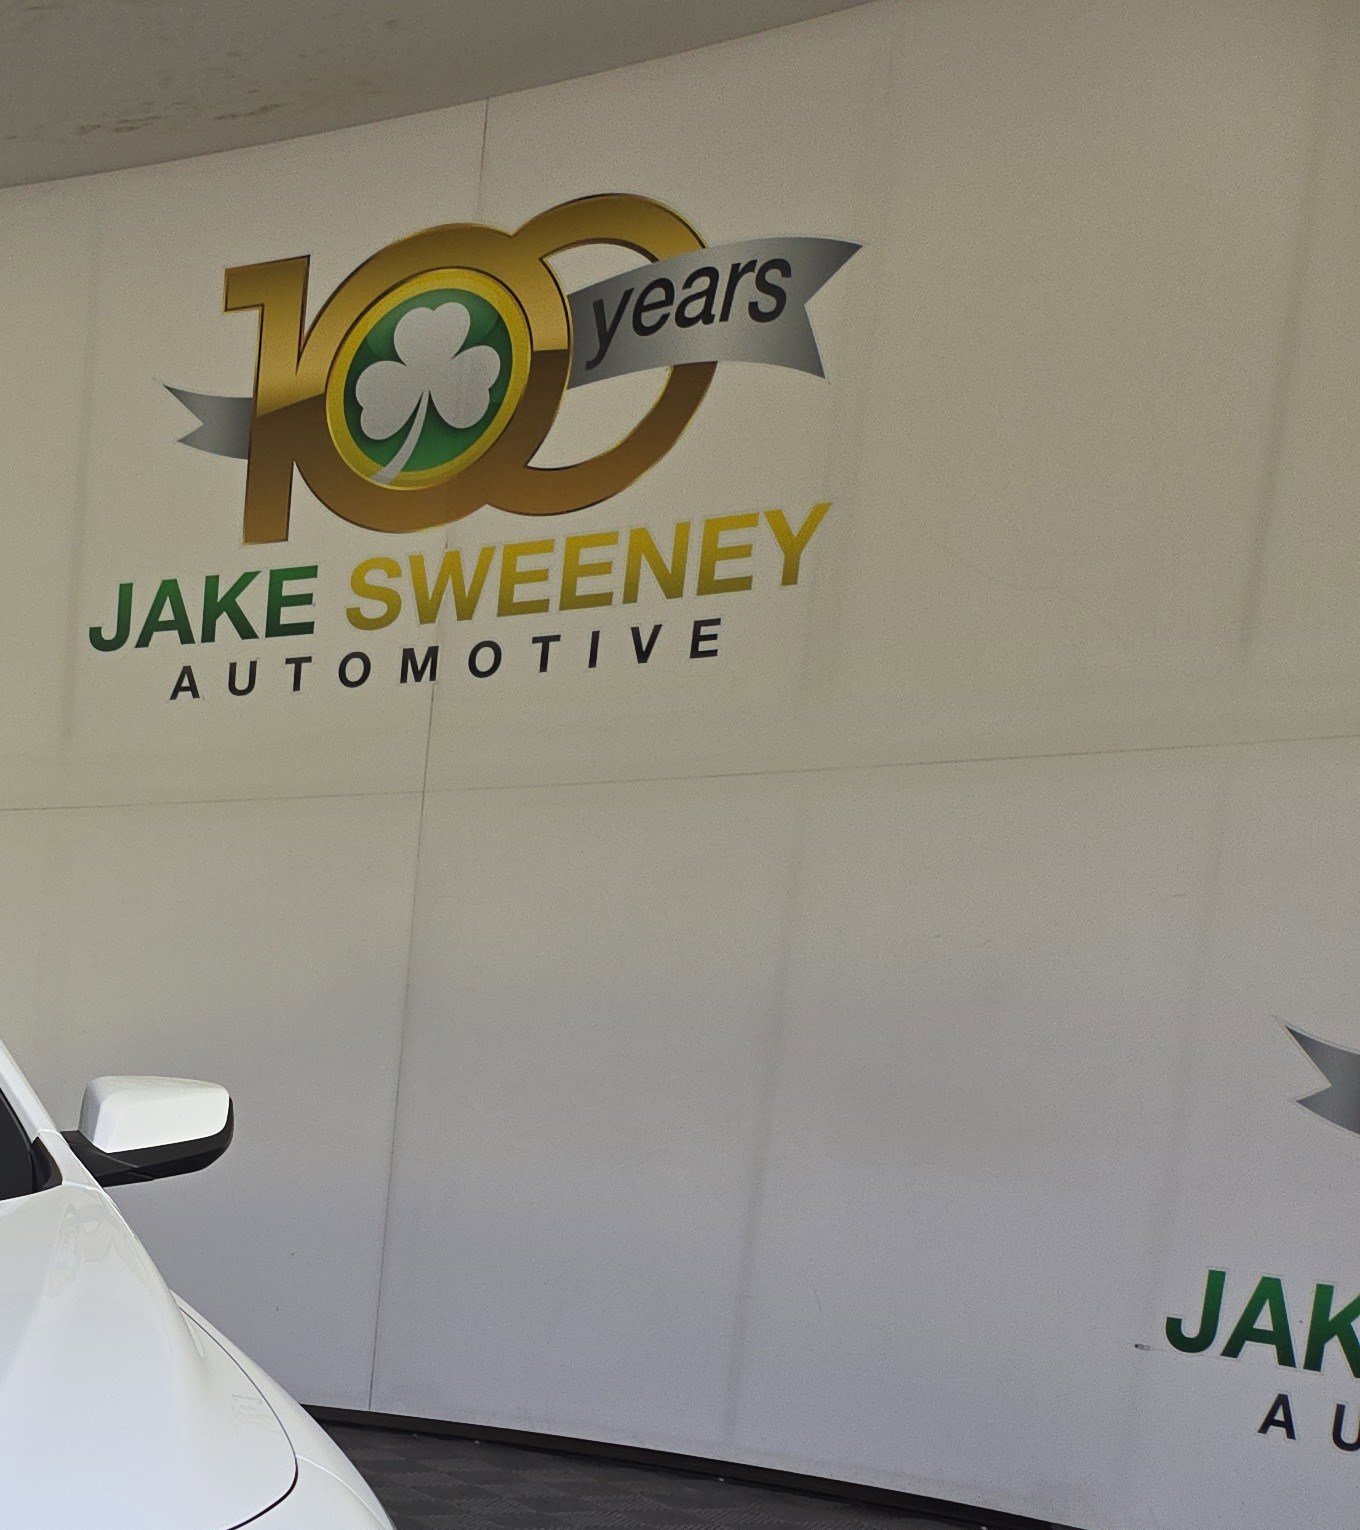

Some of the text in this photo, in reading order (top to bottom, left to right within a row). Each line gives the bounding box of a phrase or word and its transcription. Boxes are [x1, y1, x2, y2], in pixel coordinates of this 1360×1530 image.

[223, 192, 718, 546] 100
[586, 257, 793, 371] years
[88, 502, 832, 653] JAKE SWEENEY
[169, 618, 723, 702] AUTOMOTIVE
